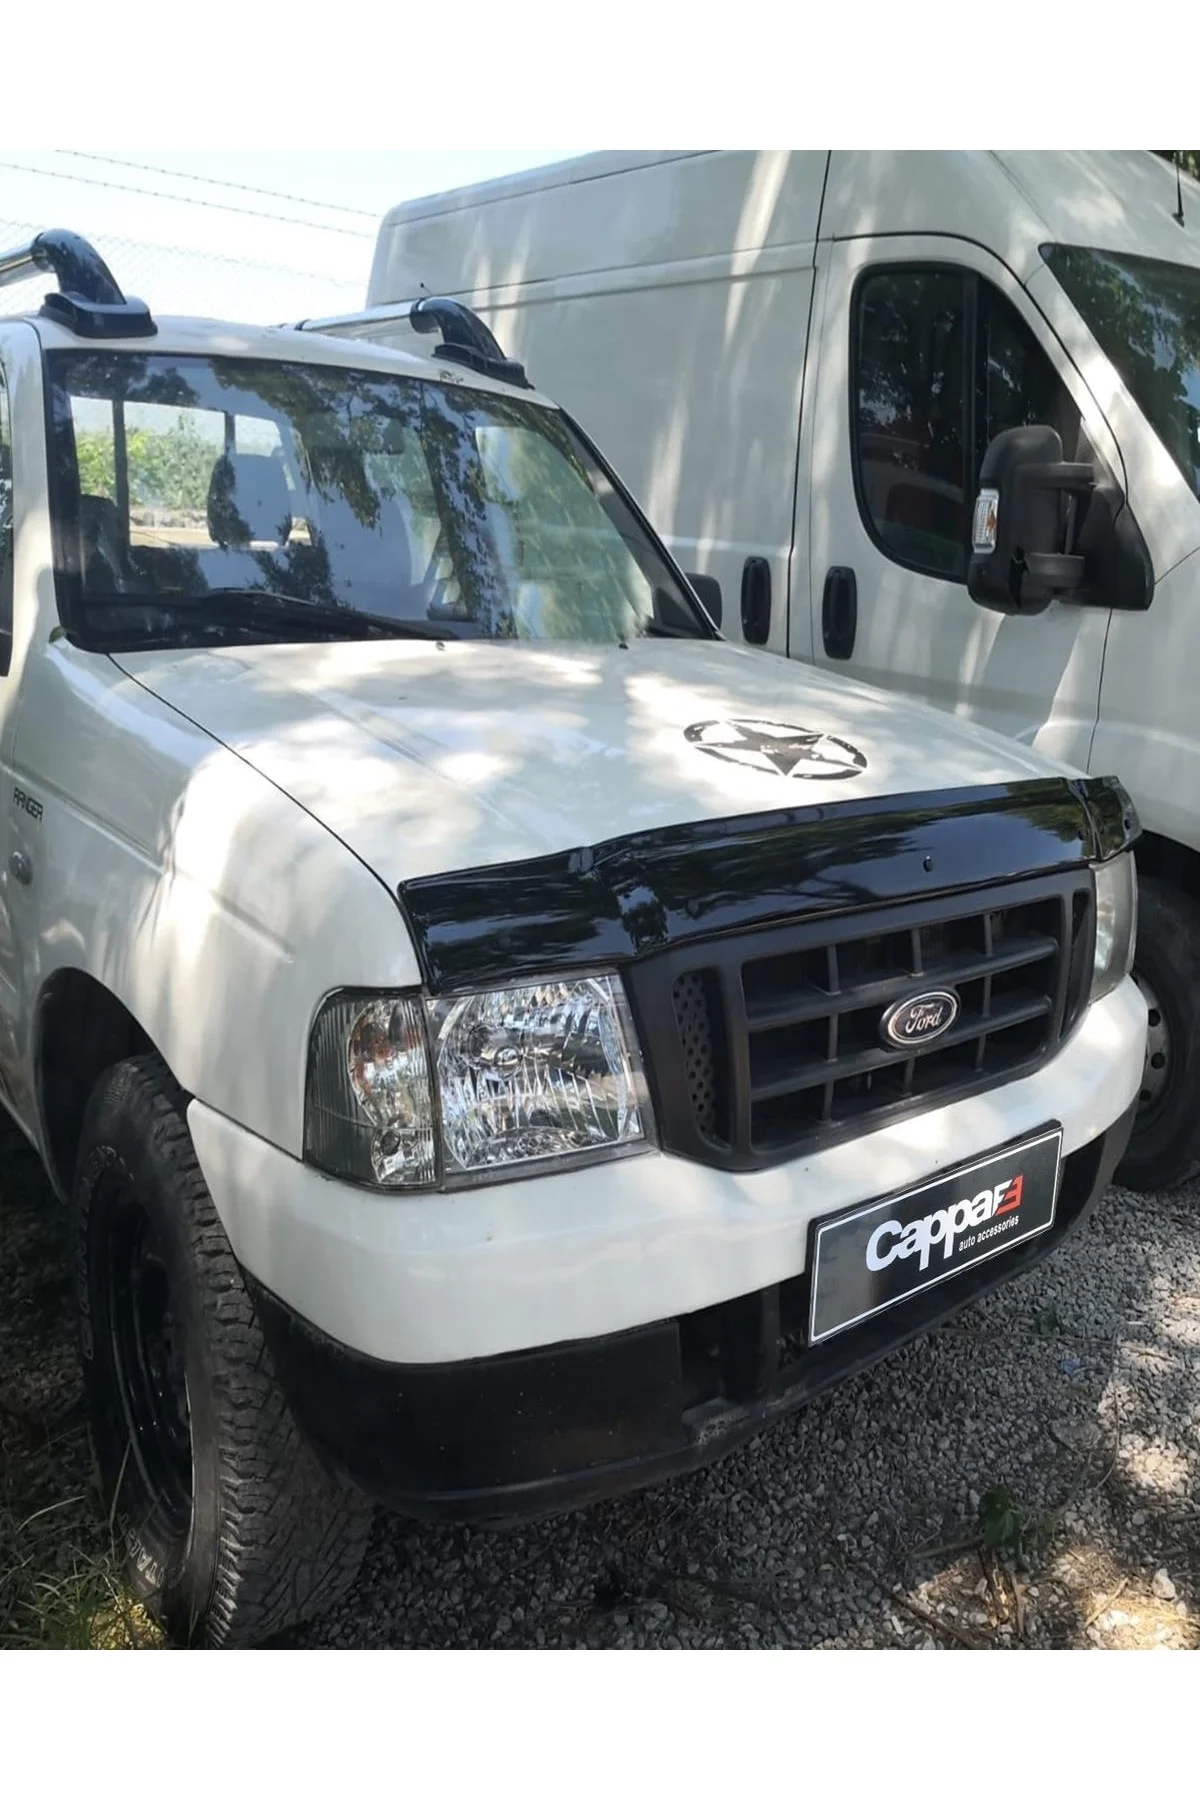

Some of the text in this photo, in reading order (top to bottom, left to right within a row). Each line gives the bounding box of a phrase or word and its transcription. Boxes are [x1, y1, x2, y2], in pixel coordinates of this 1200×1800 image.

[905, 1002, 944, 1034] Ford
[958, 1215, 1020, 1252] auto accessories
